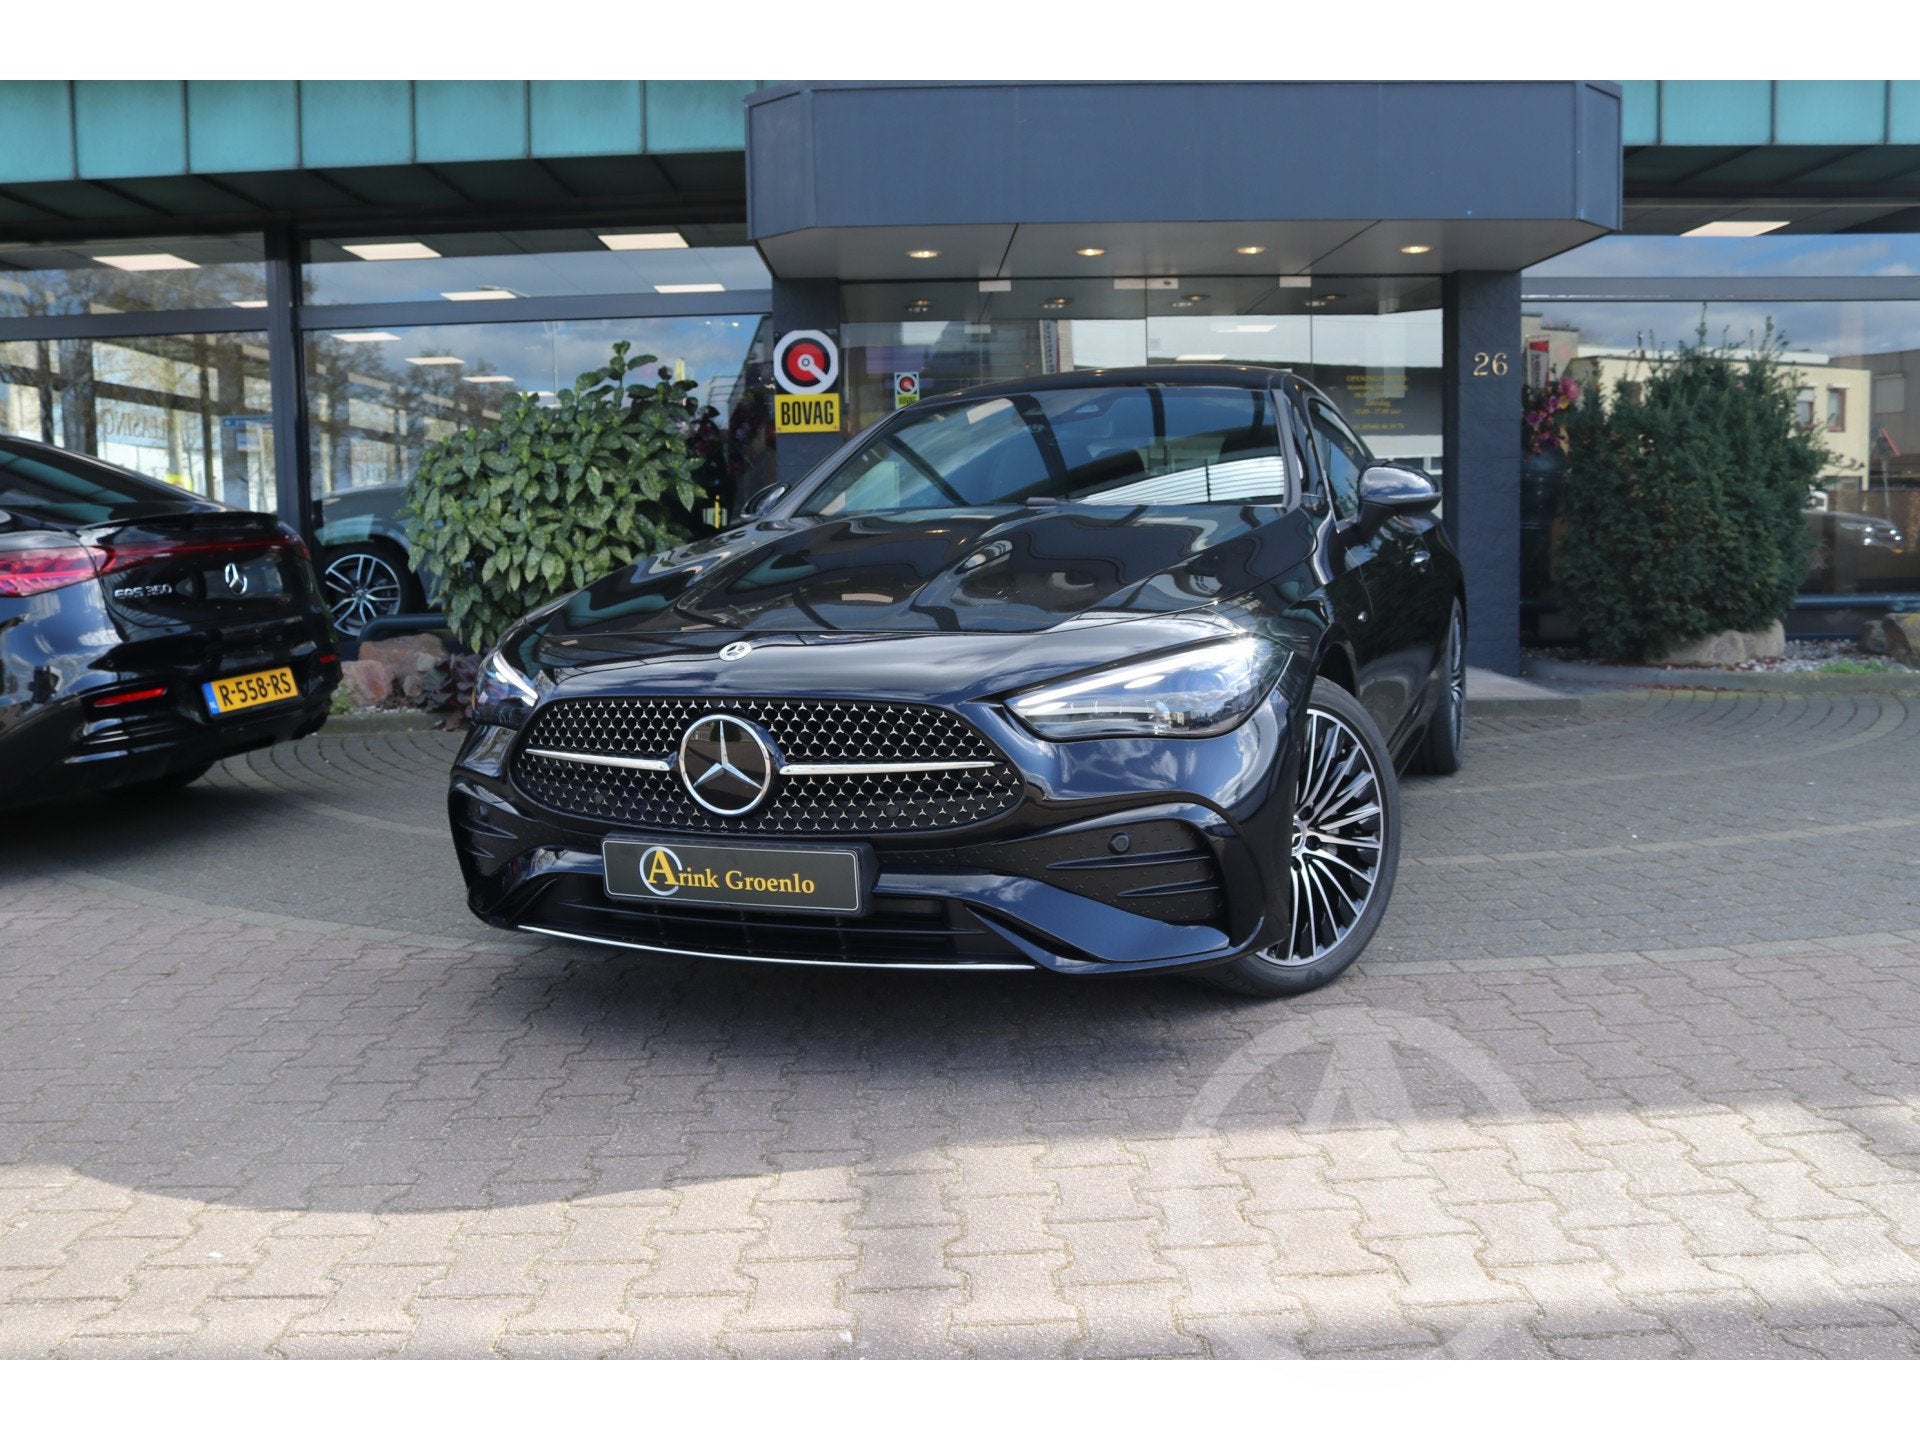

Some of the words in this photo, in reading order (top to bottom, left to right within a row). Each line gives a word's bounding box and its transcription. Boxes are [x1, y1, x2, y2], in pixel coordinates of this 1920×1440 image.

[1473, 352, 1508, 376] 26
[781, 401, 834, 426] BOVAG
[218, 672, 292, 707] R-558-RS
[725, 870, 815, 894] Groenlo
